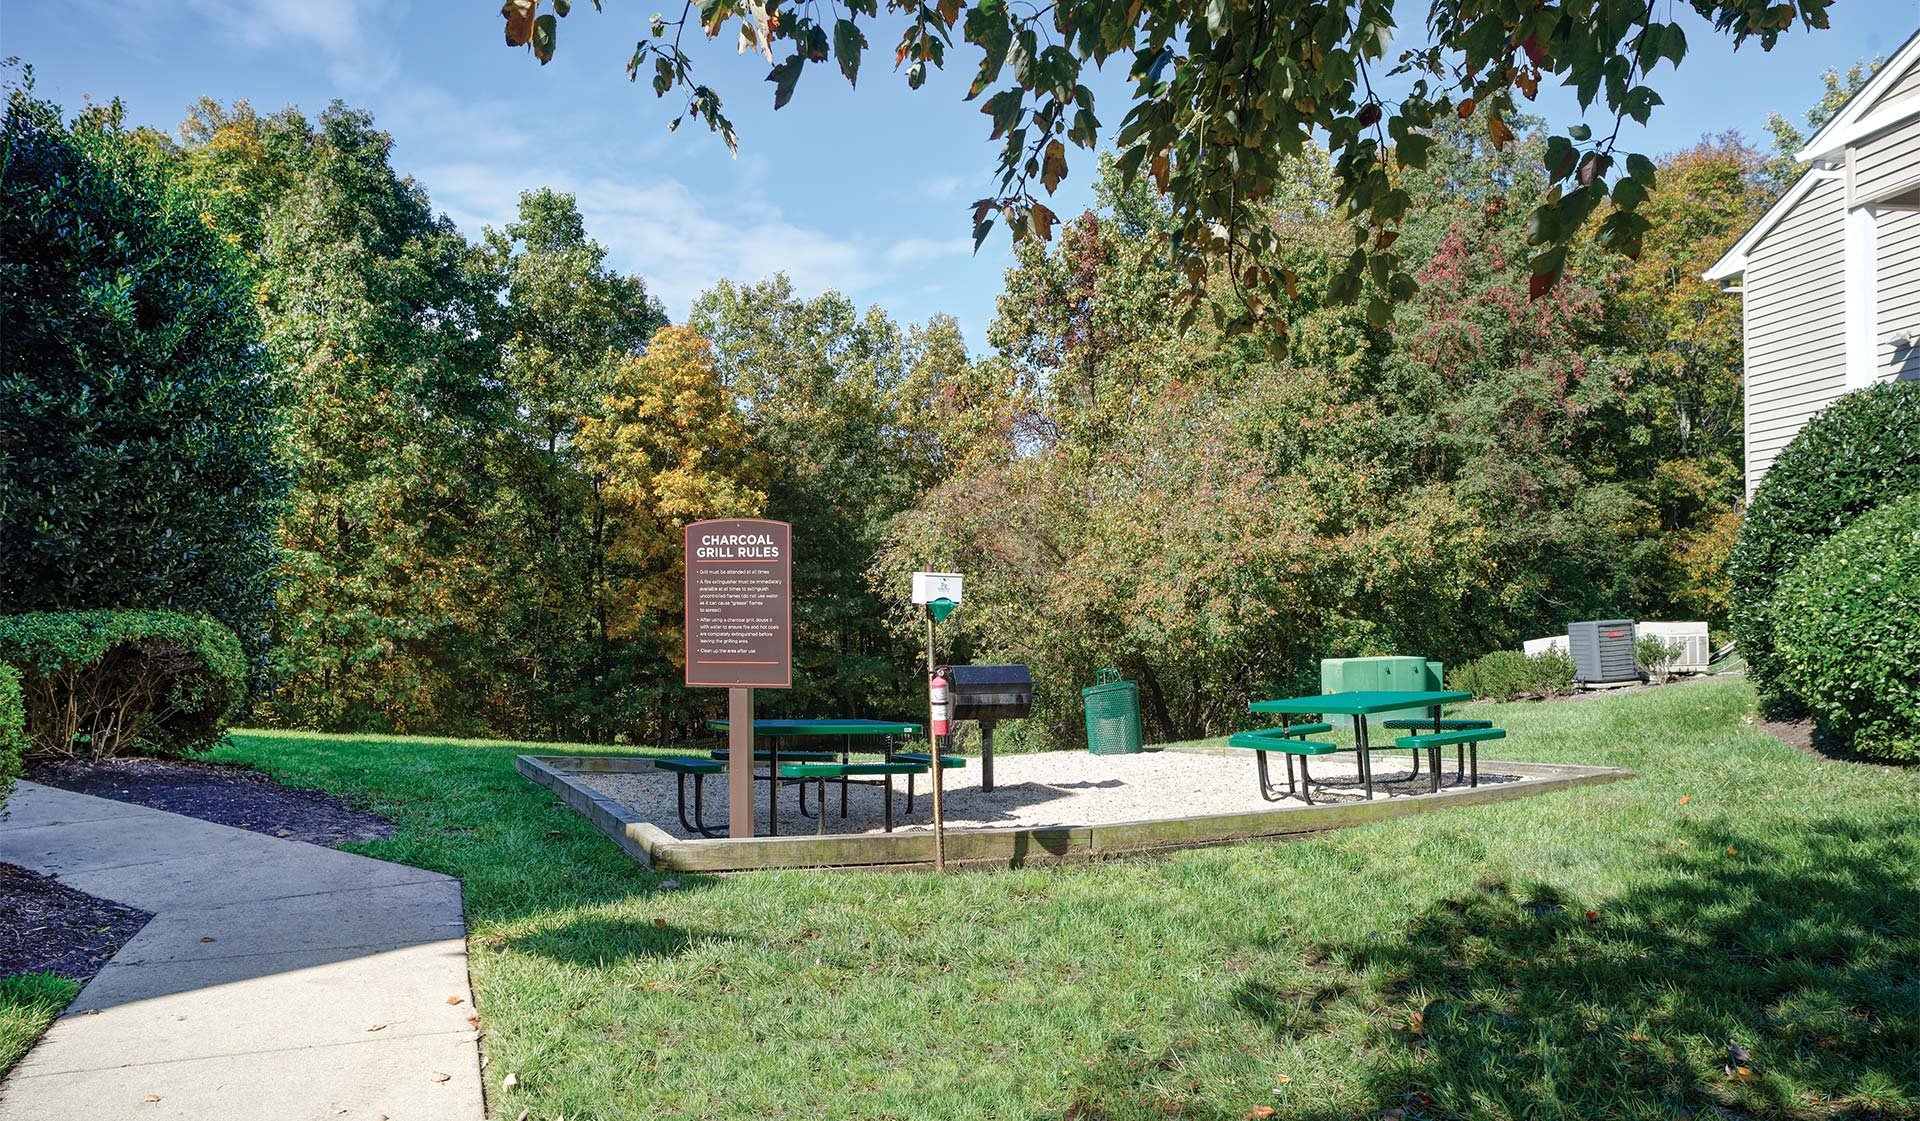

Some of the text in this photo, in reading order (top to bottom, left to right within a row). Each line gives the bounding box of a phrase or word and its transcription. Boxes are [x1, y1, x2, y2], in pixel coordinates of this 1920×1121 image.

[702, 535, 773, 545] CHARCOAL
[696, 547, 779, 557] GRILL RULES
